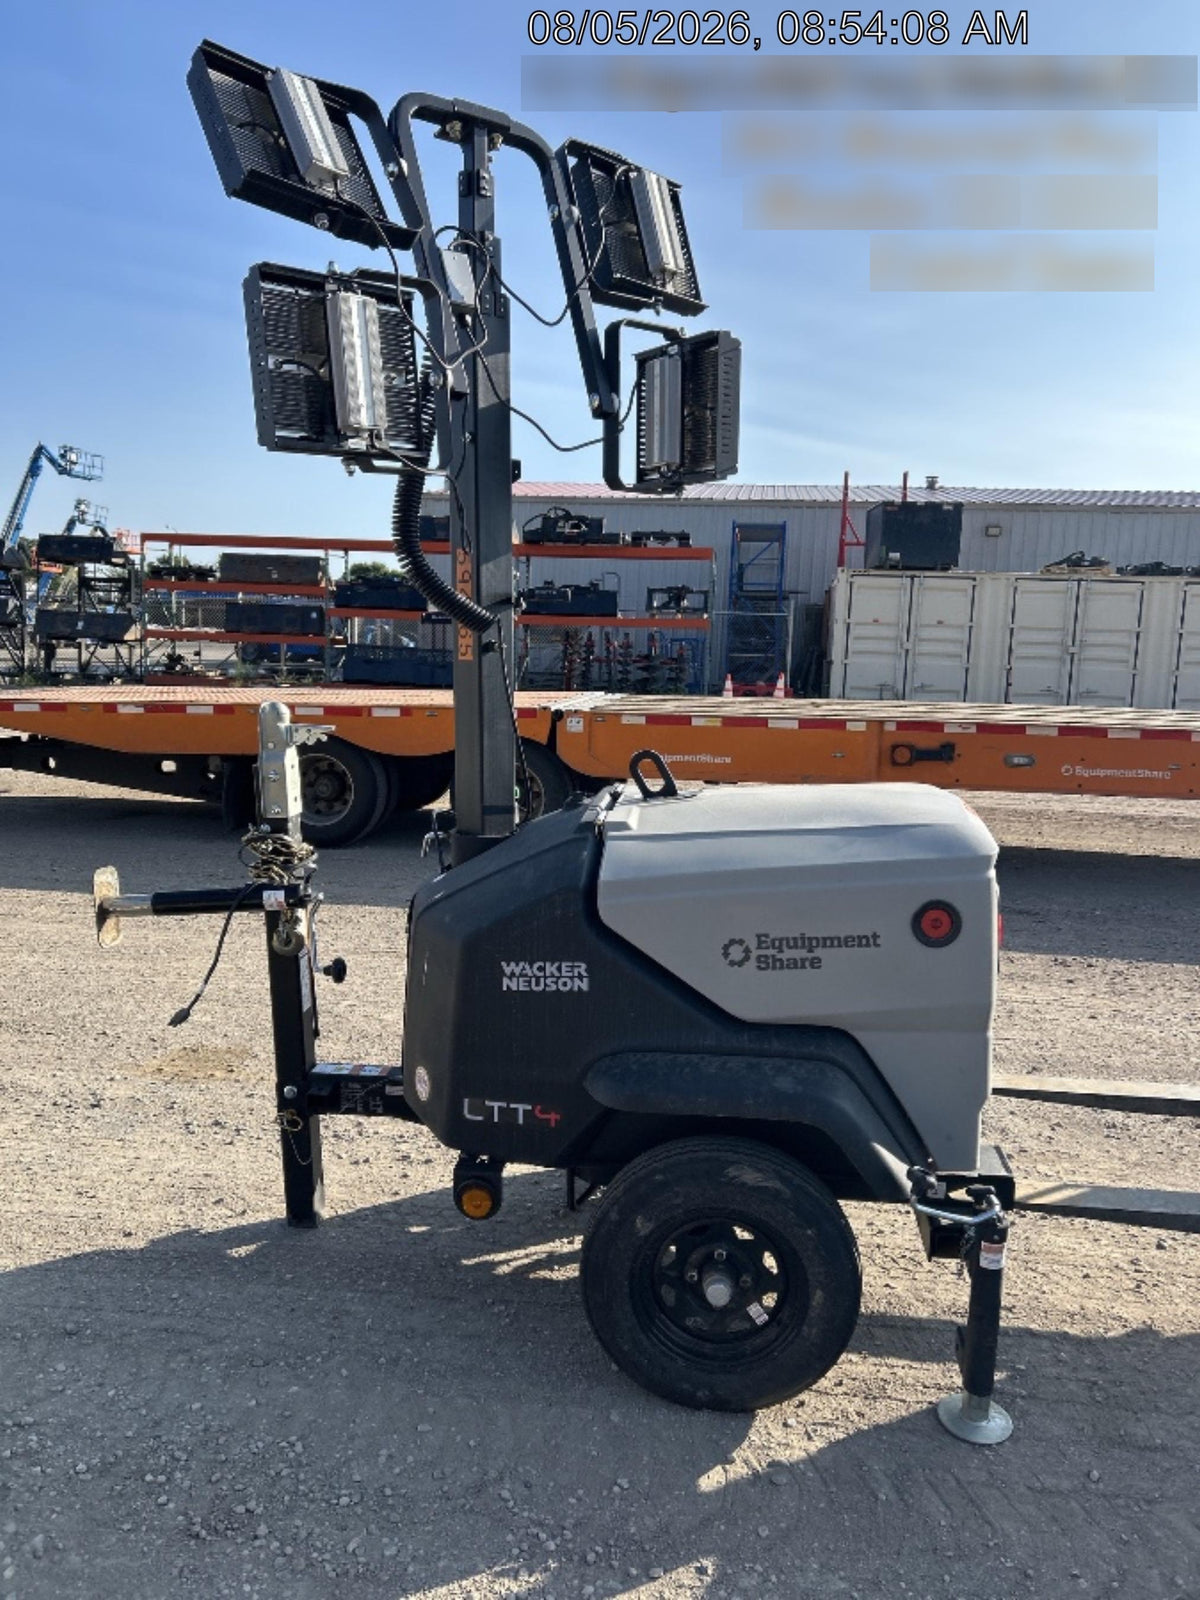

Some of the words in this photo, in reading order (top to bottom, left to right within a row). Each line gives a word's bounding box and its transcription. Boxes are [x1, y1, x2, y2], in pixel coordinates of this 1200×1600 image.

[1074, 765, 1172, 779] EquipmentShare
[755, 932, 881, 954] Equipment
[501, 961, 589, 977] WACKER
[755, 954, 822, 971] Share
[502, 977, 589, 992] NEUSON
[463, 1098, 561, 1127] LTT4
